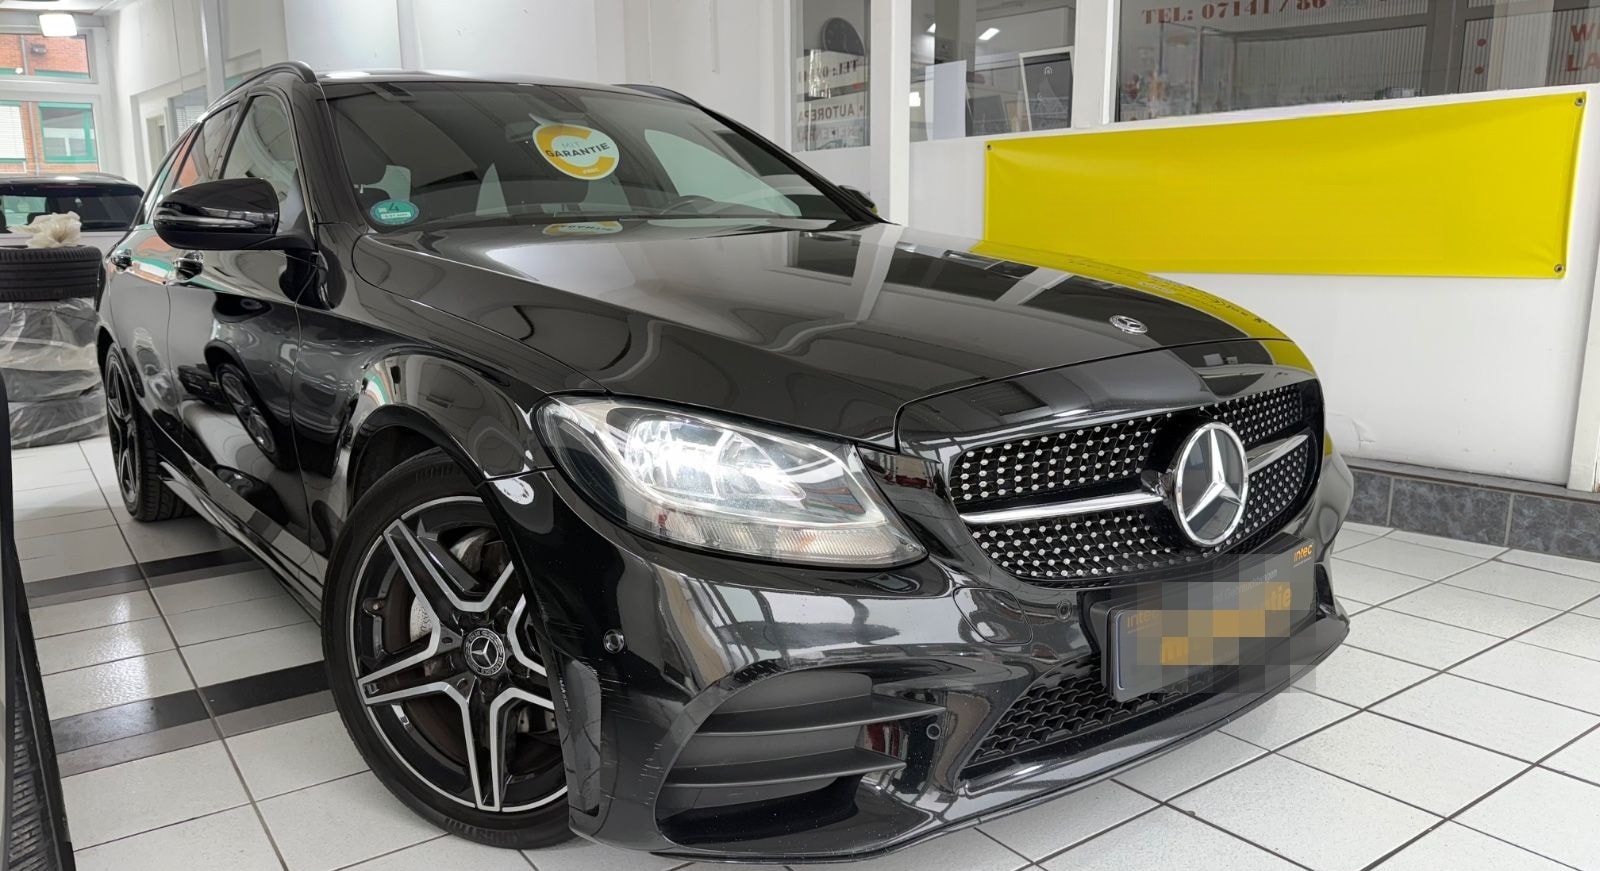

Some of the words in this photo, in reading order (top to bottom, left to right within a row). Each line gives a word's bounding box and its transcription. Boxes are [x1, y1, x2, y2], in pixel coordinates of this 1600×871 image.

[1142, 7, 1193, 24] TEL:
[544, 142, 610, 158] GARANTIE
[1293, 543, 1313, 562] intec
